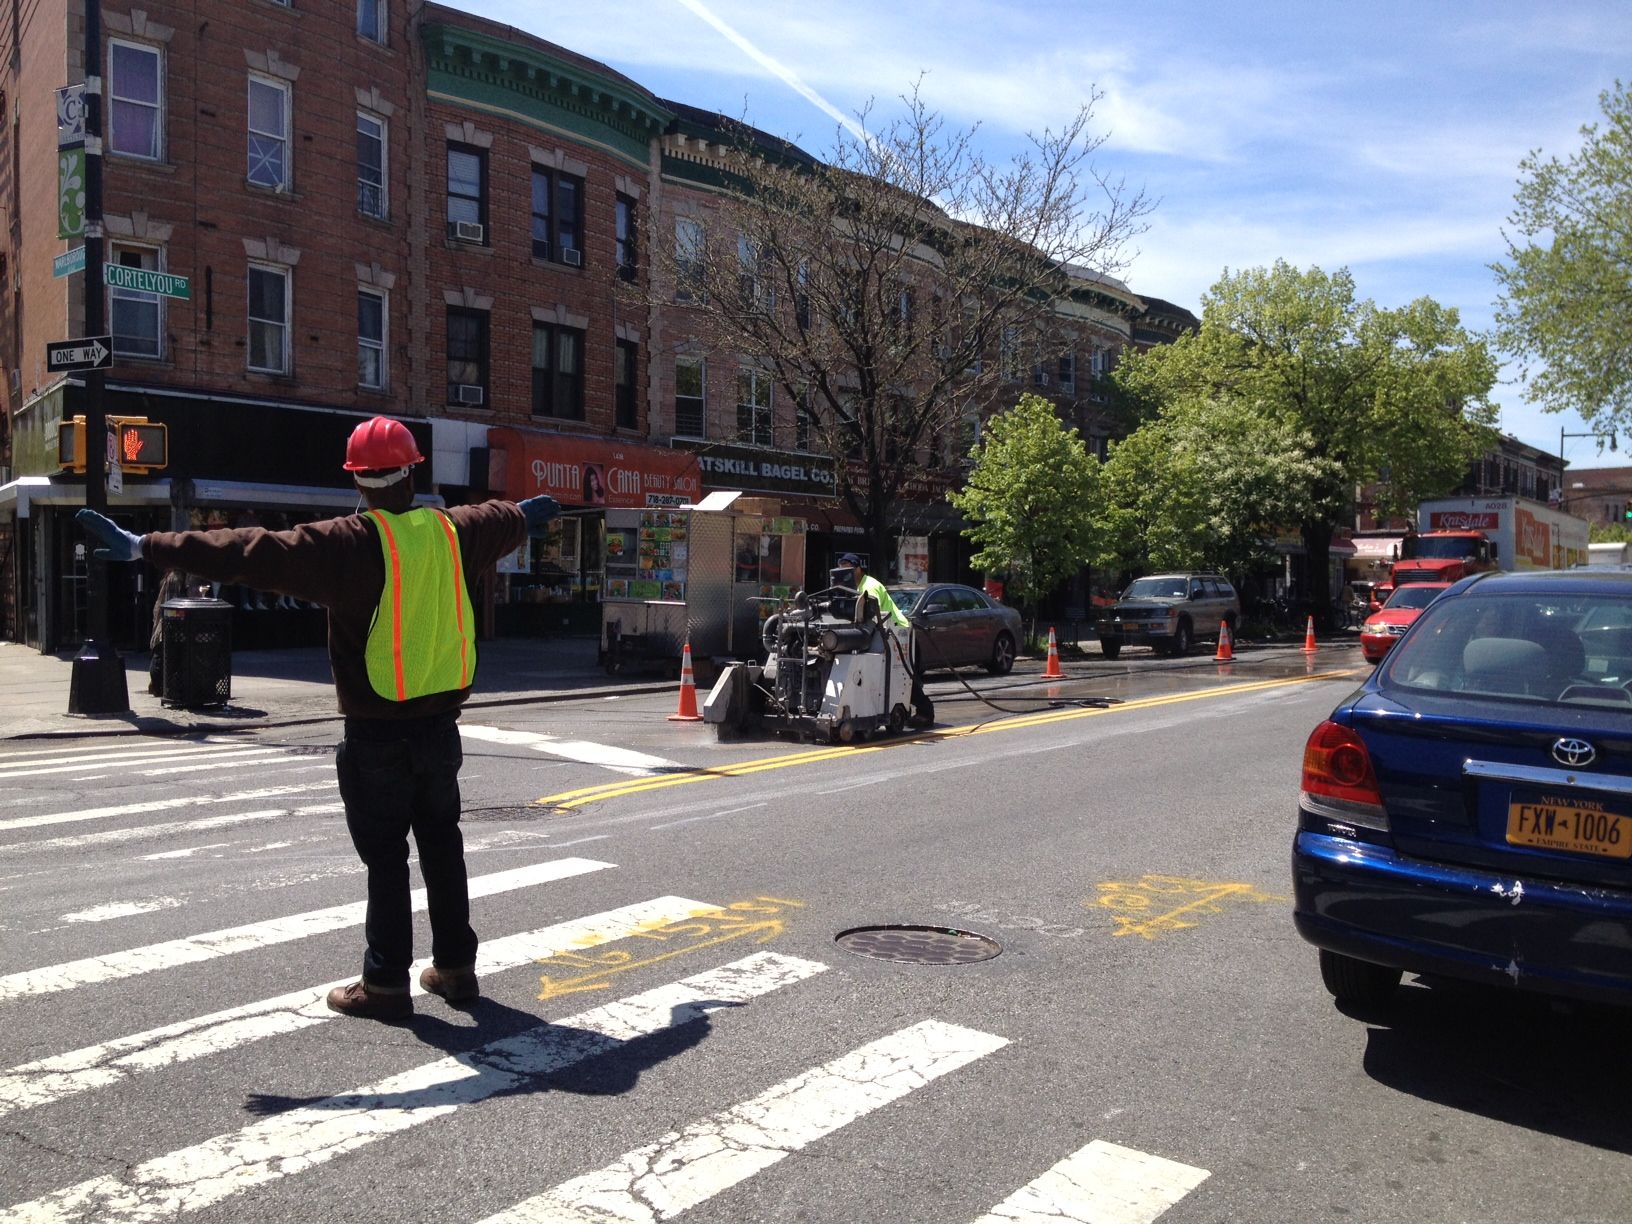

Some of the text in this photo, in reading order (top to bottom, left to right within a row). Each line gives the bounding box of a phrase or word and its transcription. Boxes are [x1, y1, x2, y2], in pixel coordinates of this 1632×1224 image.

[108, 266, 187, 295] CORTELYOU RD
[56, 346, 103, 363] ONE WAY
[532, 459, 698, 495] PUNTA CANA BEAUTY SALON
[697, 456, 758, 477] ATSKILL
[761, 463, 808, 481] BAGEL
[811, 467, 834, 484] CO.
[1541, 795, 1605, 812] NEW YORK
[1518, 806, 1621, 845] FXW 1006
